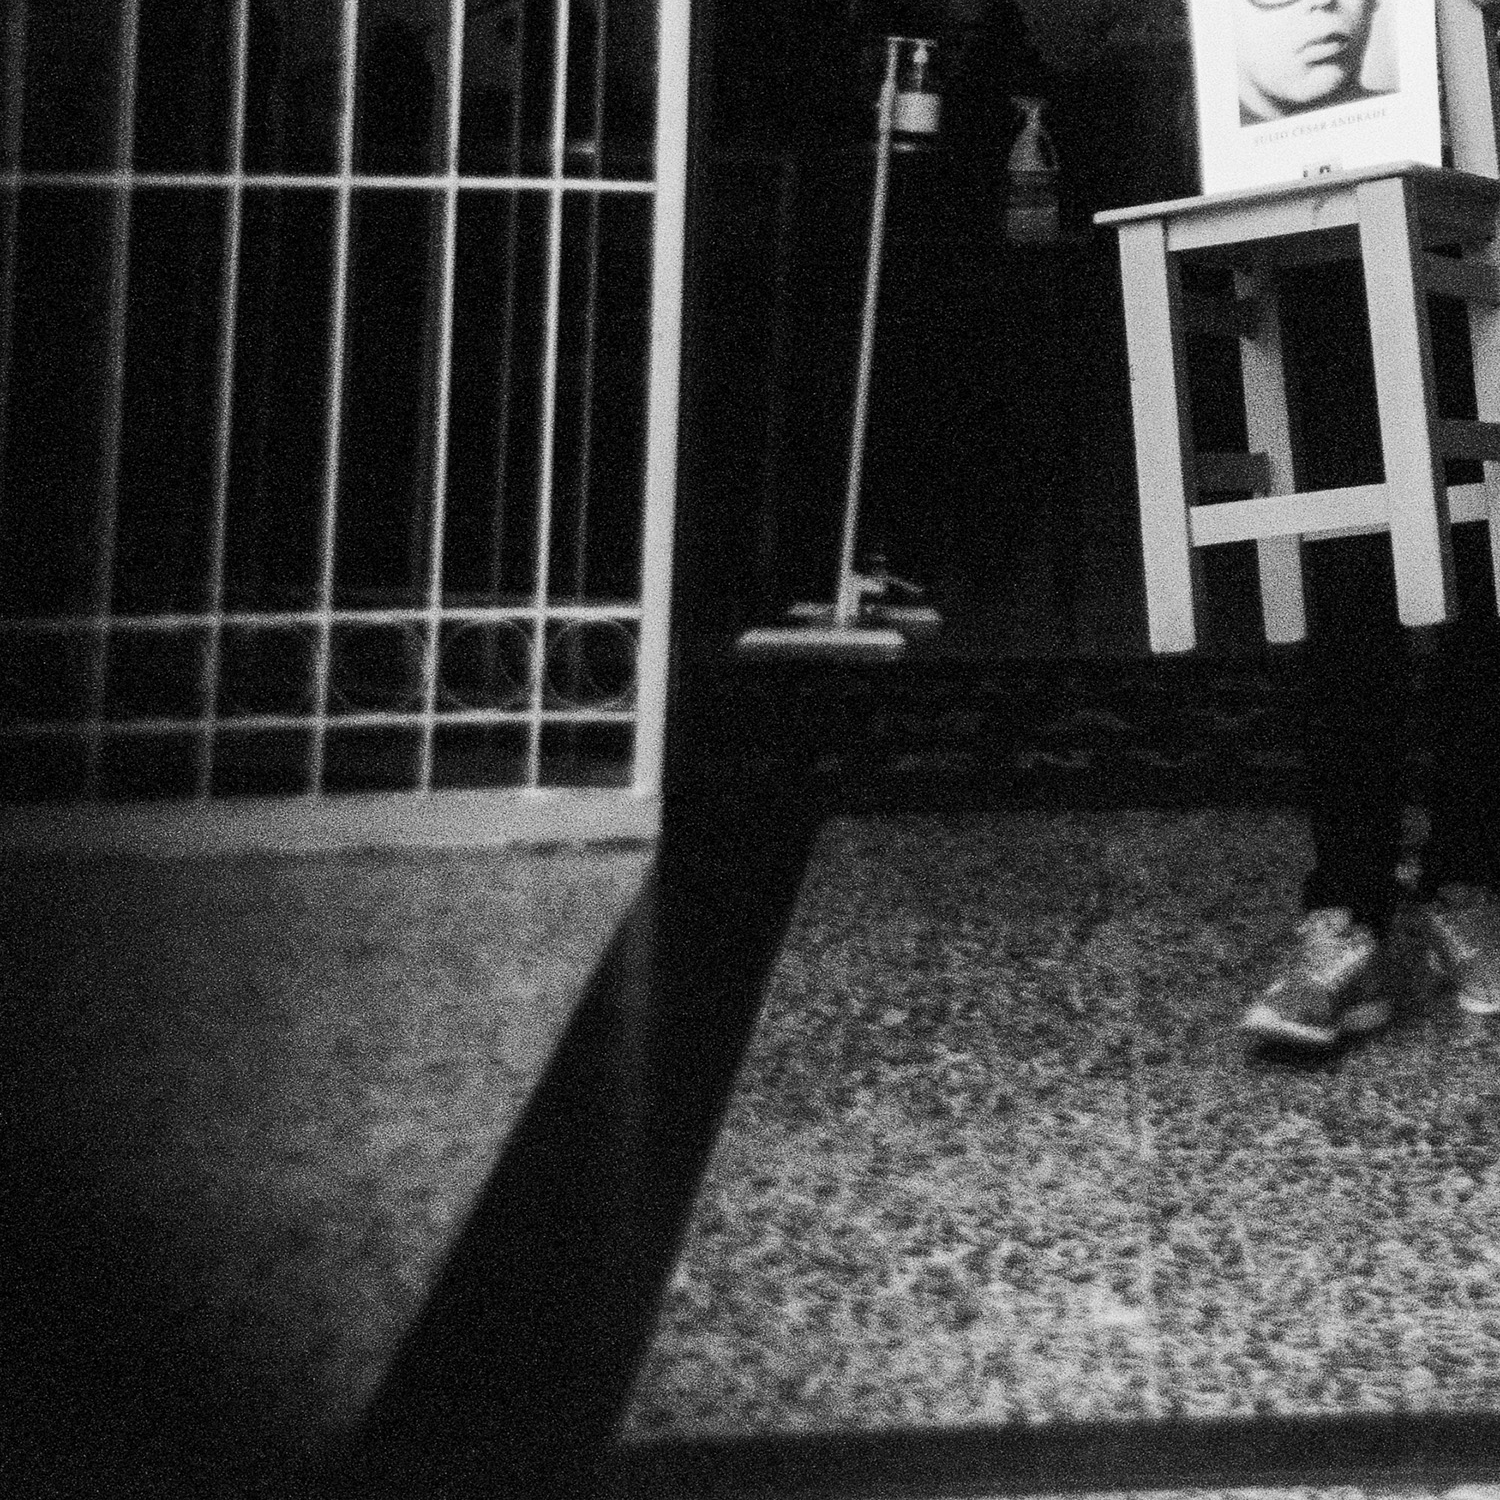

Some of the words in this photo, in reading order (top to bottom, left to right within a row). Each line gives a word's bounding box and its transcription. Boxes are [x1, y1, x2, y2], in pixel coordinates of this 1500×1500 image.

[1253, 130, 1290, 148] JULIO
[1291, 121, 1327, 138] CESAR
[1330, 107, 1387, 129] ANDRADE
